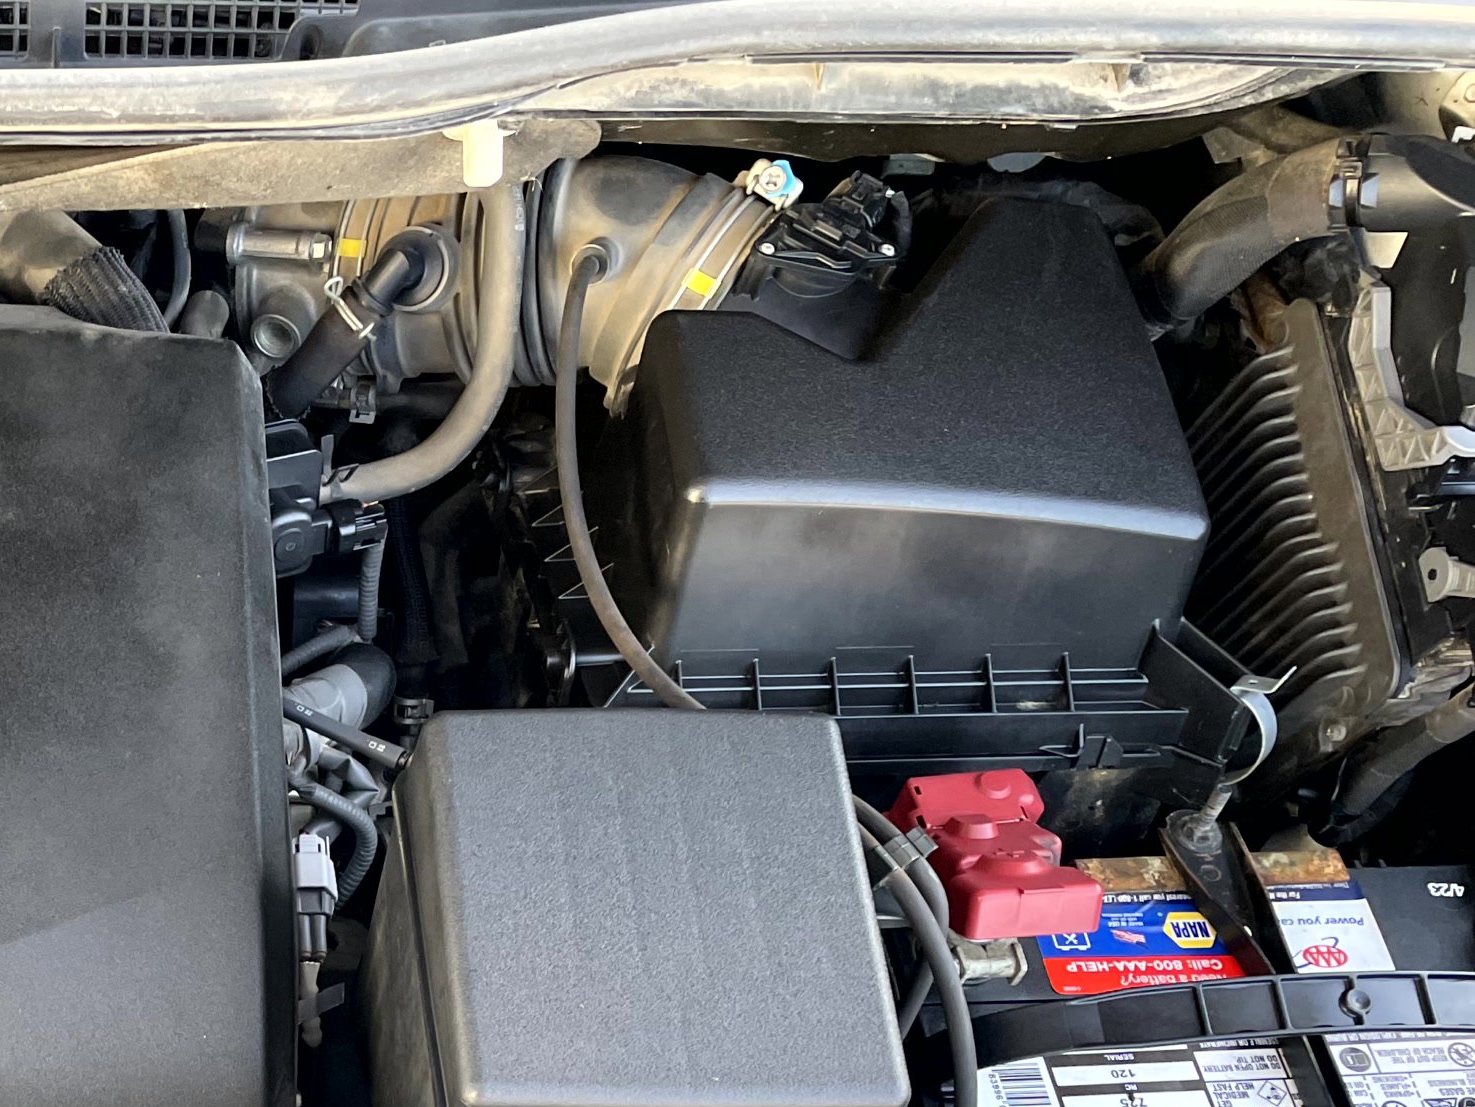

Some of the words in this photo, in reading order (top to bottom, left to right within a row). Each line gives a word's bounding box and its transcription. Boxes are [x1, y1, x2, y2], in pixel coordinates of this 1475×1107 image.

[1298, 916, 1320, 925] you
[1325, 917, 1364, 926] Power
[1170, 921, 1211, 938] NAPA
[1065, 960, 1183, 972] 800-AAA-HELP
[1186, 959, 1223, 971] Call:
[1110, 1069, 1136, 1078] 120
[1125, 1083, 1138, 1091] RC
[1234, 1082, 1254, 1091] HELP
[1213, 1091, 1250, 1099] MEDICAL
[1119, 1098, 1147, 1107] 725
[1217, 1100, 1233, 1107] GET
